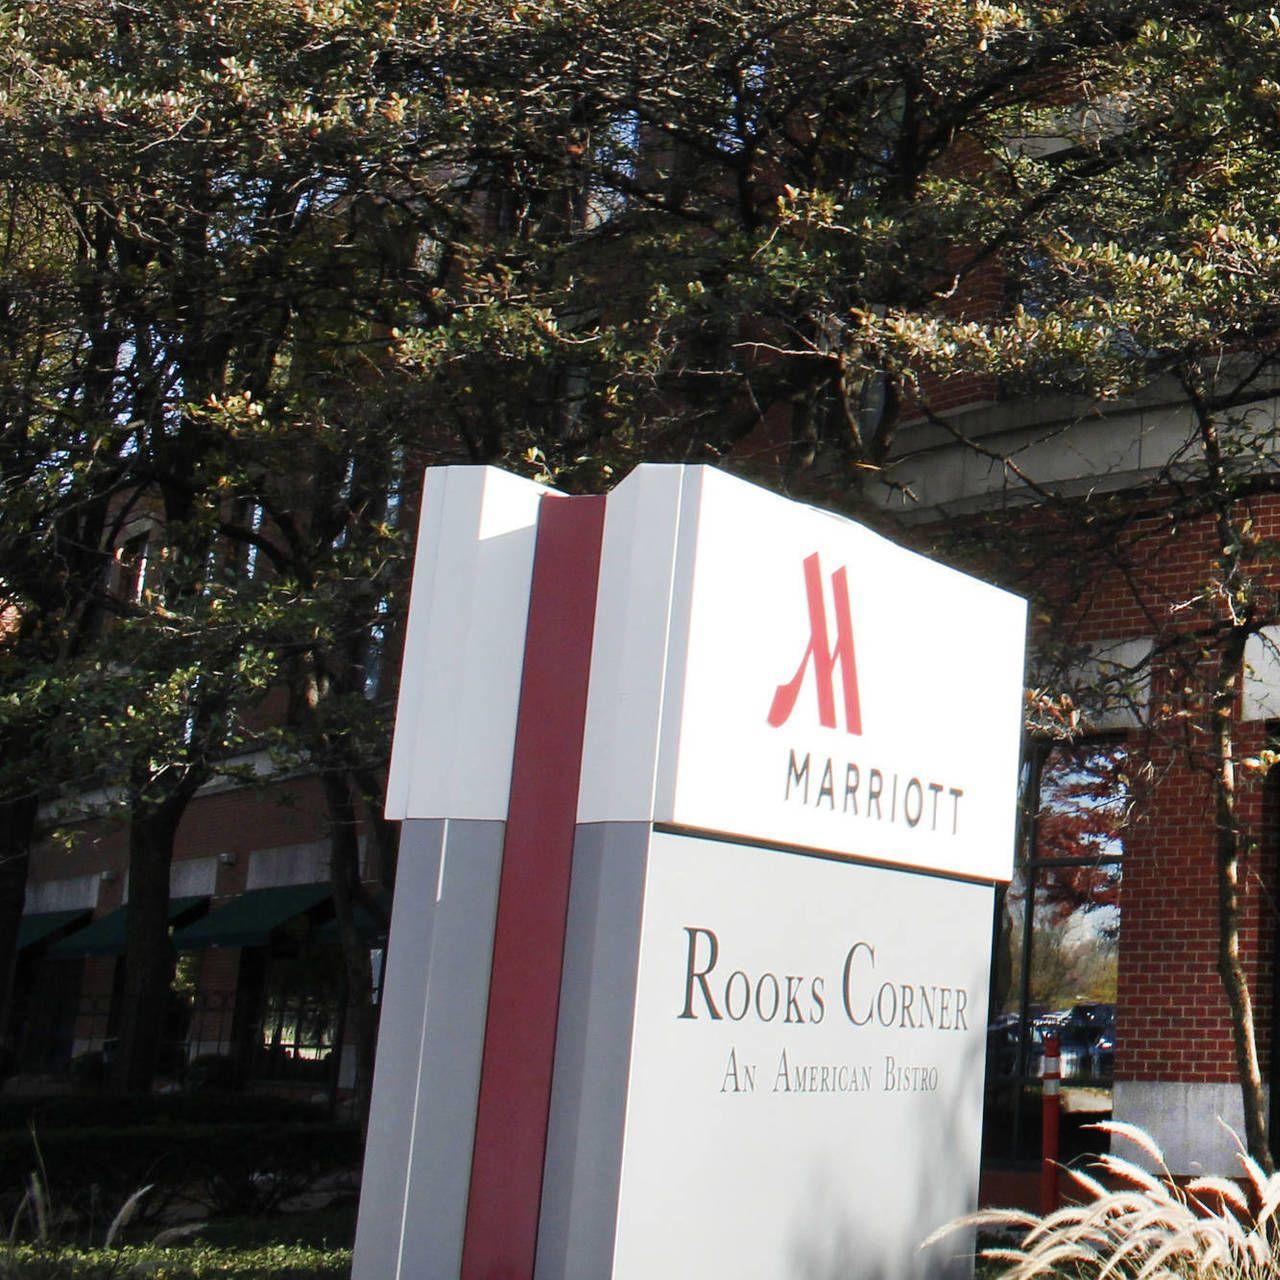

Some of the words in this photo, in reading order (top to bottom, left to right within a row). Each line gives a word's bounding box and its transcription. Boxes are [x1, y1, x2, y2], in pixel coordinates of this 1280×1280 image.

[784, 748, 964, 835] MARRIOTT
[677, 926, 825, 1026] ROOKS
[842, 942, 969, 1032] CORNER
[720, 1047, 756, 1094] AN
[772, 1048, 872, 1095] AMERICAN
[883, 1056, 939, 1094] BISTRO
